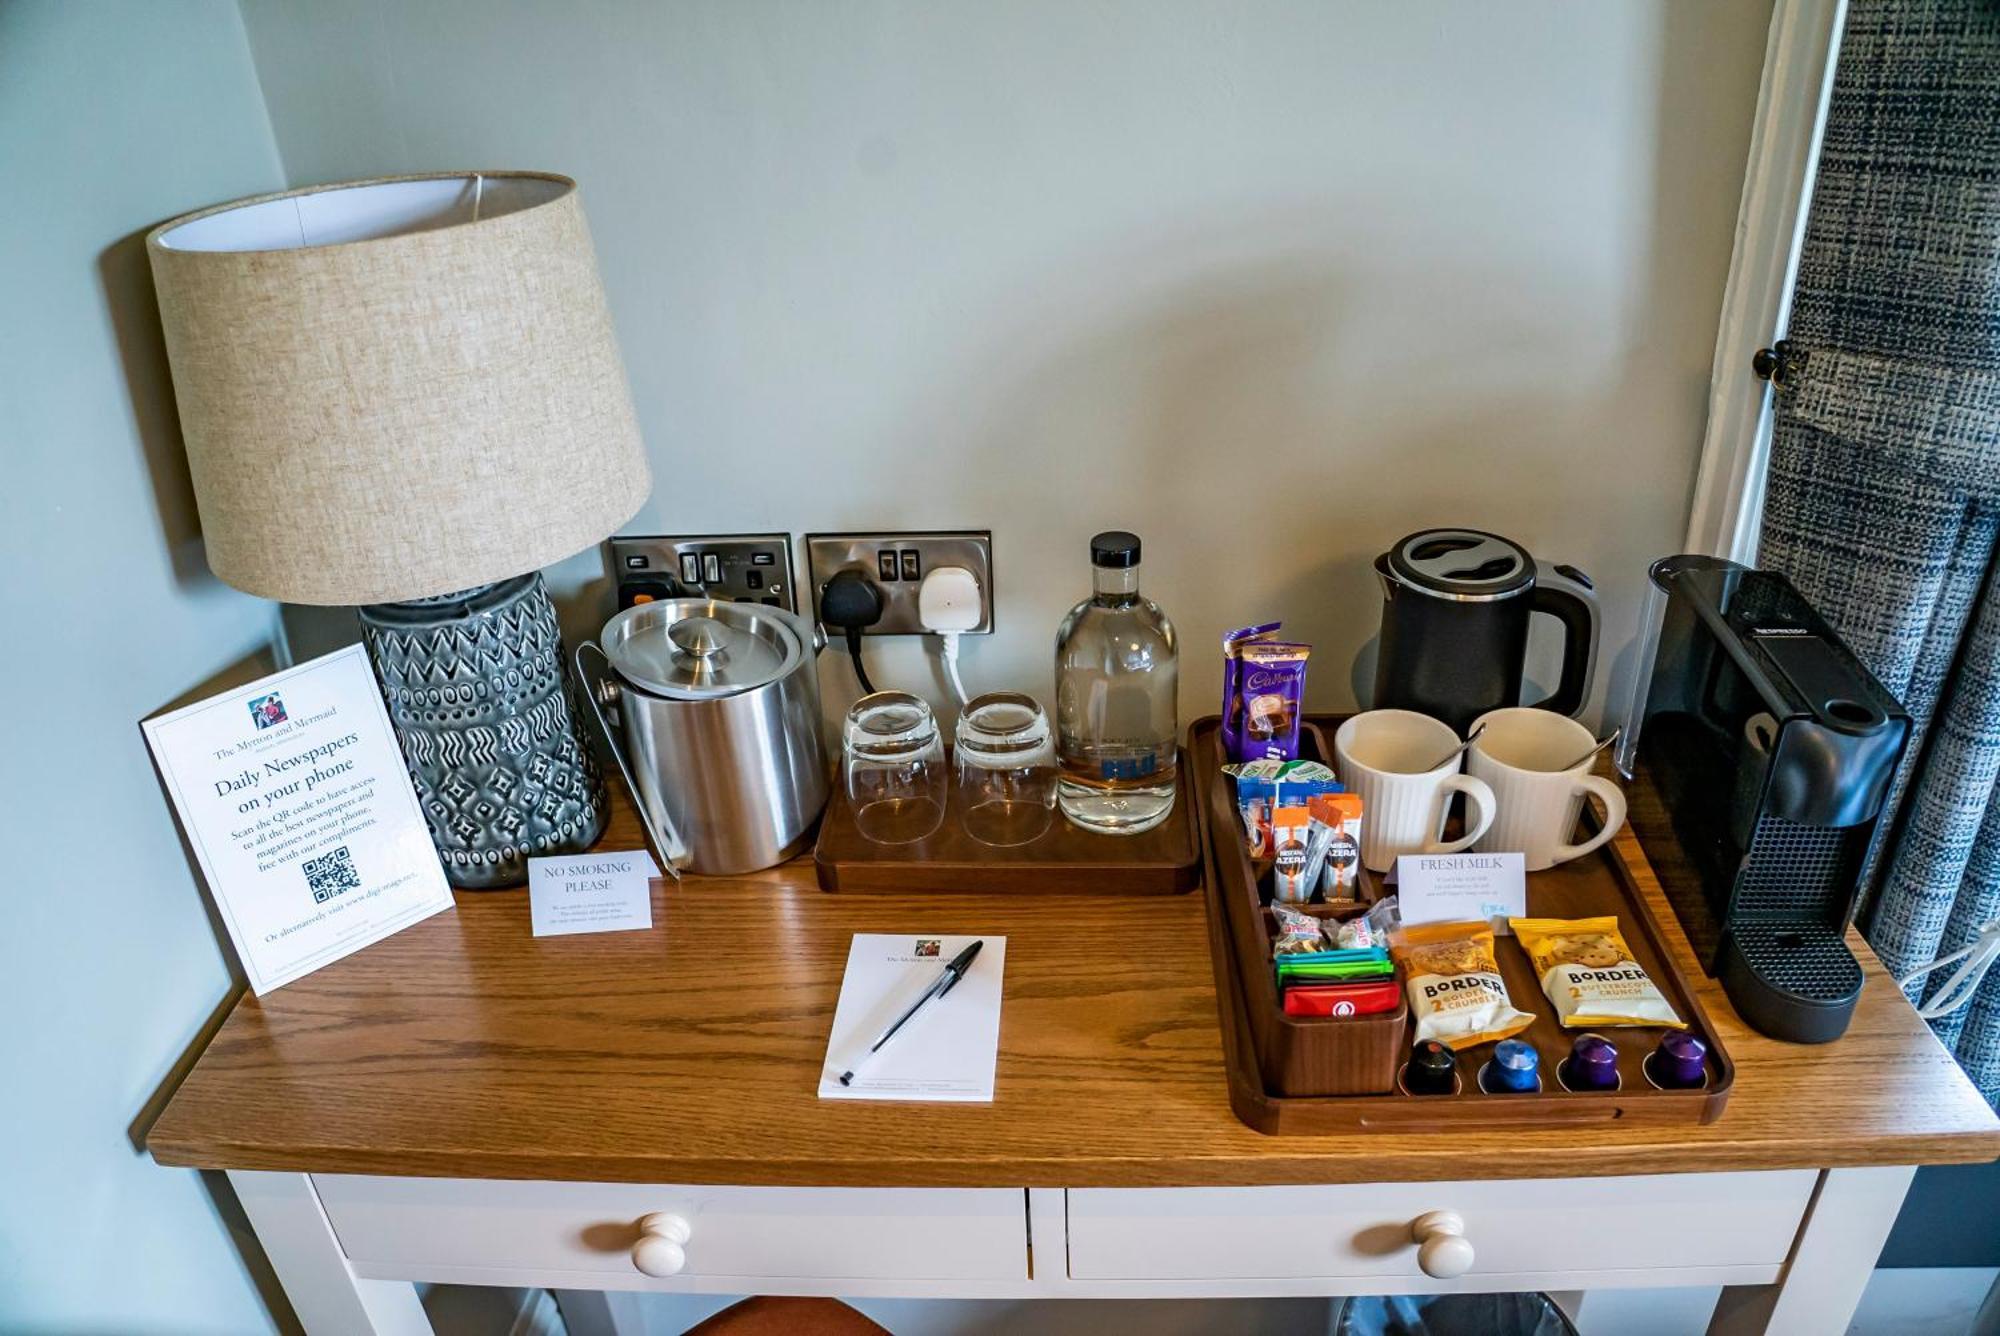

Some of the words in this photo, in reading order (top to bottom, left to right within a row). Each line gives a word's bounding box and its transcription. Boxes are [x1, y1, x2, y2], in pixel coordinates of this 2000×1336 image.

[213, 749, 234, 760] The
[275, 724, 293, 737] and
[294, 706, 337, 730] Mermaid
[214, 770, 260, 797] Daily
[264, 732, 359, 777] Newspapers
[238, 799, 260, 814] on
[264, 780, 300, 808] your
[304, 759, 354, 791] phone
[231, 827, 254, 840] Scan
[256, 819, 271, 830] the
[272, 810, 290, 823] QR
[292, 801, 314, 815] code
[316, 796, 326, 805] to
[327, 787, 348, 801] have
[350, 777, 375, 791] access
[243, 842, 254, 850] to
[256, 833, 266, 845] all
[269, 828, 283, 840] the
[285, 820, 304, 833] best
[306, 799, 356, 824] newspapers
[358, 788, 374, 802] and
[256, 835, 303, 859] magazines
[304, 829, 317, 838] on
[319, 820, 339, 834] your
[257, 860, 276, 873] free
[278, 850, 299, 864] with
[300, 843, 316, 855] our
[544, 867, 565, 879] NO
[568, 862, 631, 877] SMOKING
[1420, 858, 1465, 871] FRESH
[1467, 856, 1503, 869] MILK
[565, 879, 613, 893] PLEASE
[264, 931, 278, 943] Or
[280, 911, 326, 937] alternatively
[328, 904, 344, 916] visit
[1424, 977, 1505, 998] BORDER
[1567, 969, 1648, 984] BORDER
[1568, 986, 1582, 999] 2
[1581, 981, 1654, 992] BUTTERSCOT
[1431, 1000, 1445, 1013] 2
